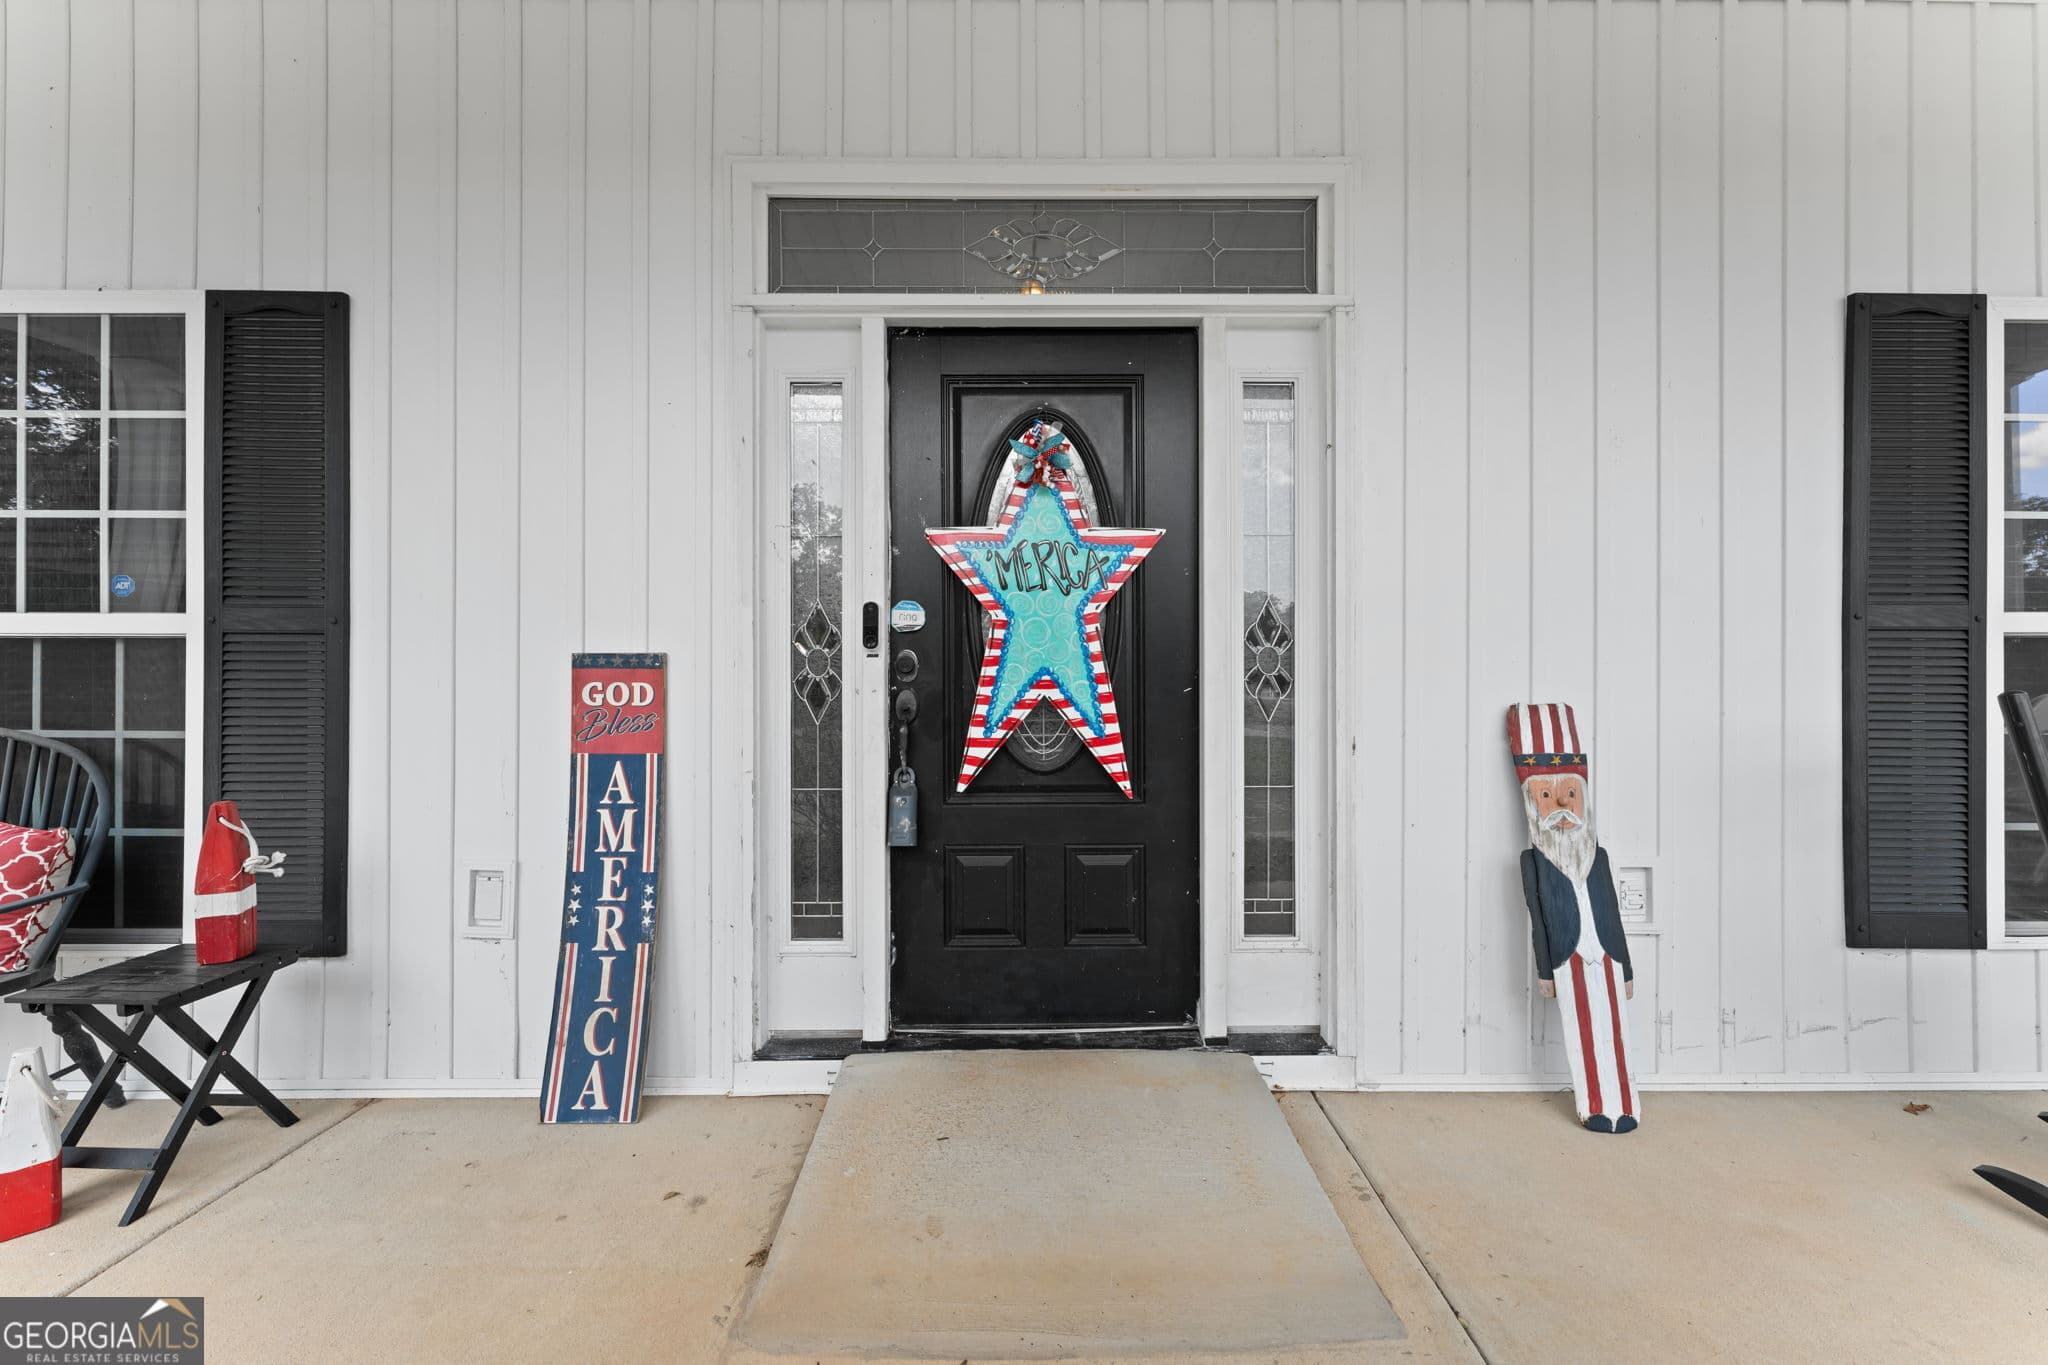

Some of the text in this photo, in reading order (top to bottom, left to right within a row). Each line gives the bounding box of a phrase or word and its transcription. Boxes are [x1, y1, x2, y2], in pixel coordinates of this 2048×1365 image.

[986, 539, 1110, 596] 'MERICA
[115, 582, 130, 590] ADT
[899, 612, 918, 624] ring
[581, 681, 655, 707] GOD
[576, 707, 660, 744] Bless
[571, 759, 638, 1111] AMERICA
